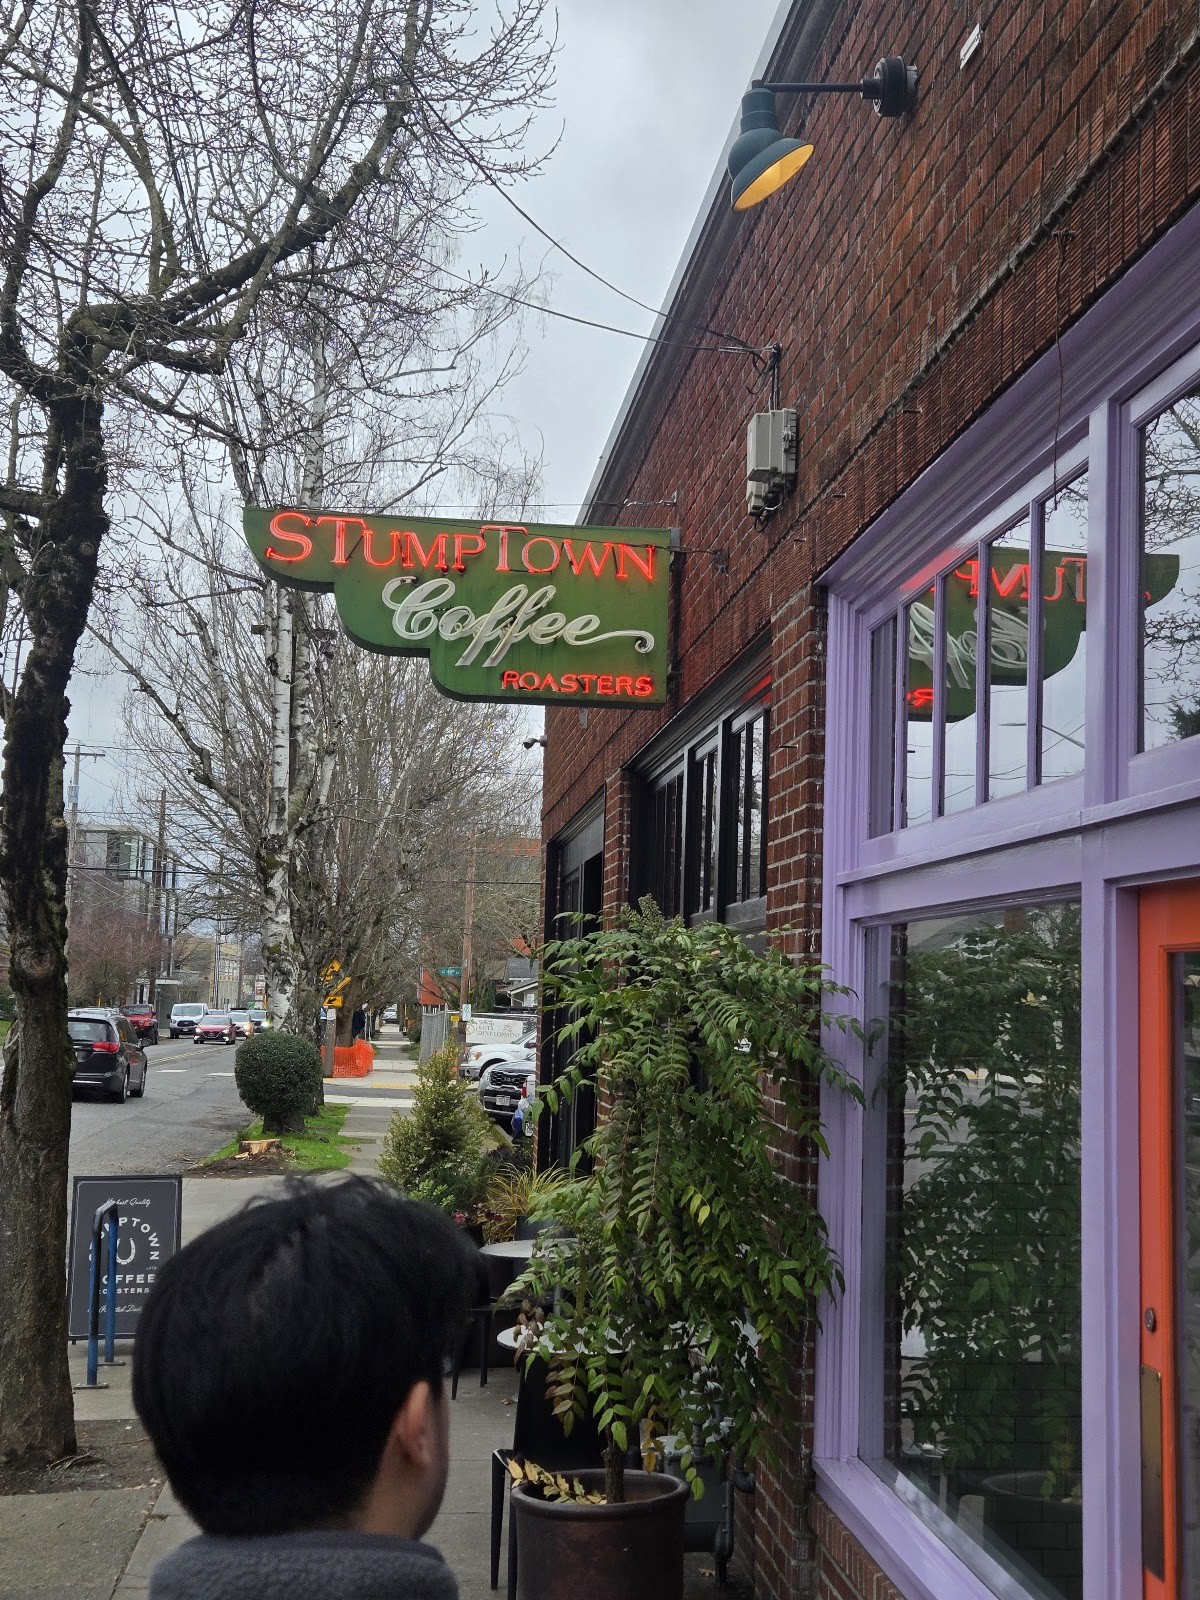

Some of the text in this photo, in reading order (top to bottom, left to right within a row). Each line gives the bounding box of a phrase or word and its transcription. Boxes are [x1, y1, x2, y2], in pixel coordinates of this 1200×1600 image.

[265, 511, 657, 580] STUMPTOWN
[381, 576, 656, 668] Coffee
[501, 670, 655, 696] ROASTERS
[129, 1197, 151, 1208] Quality
[101, 1273, 156, 1285] OFFEE
